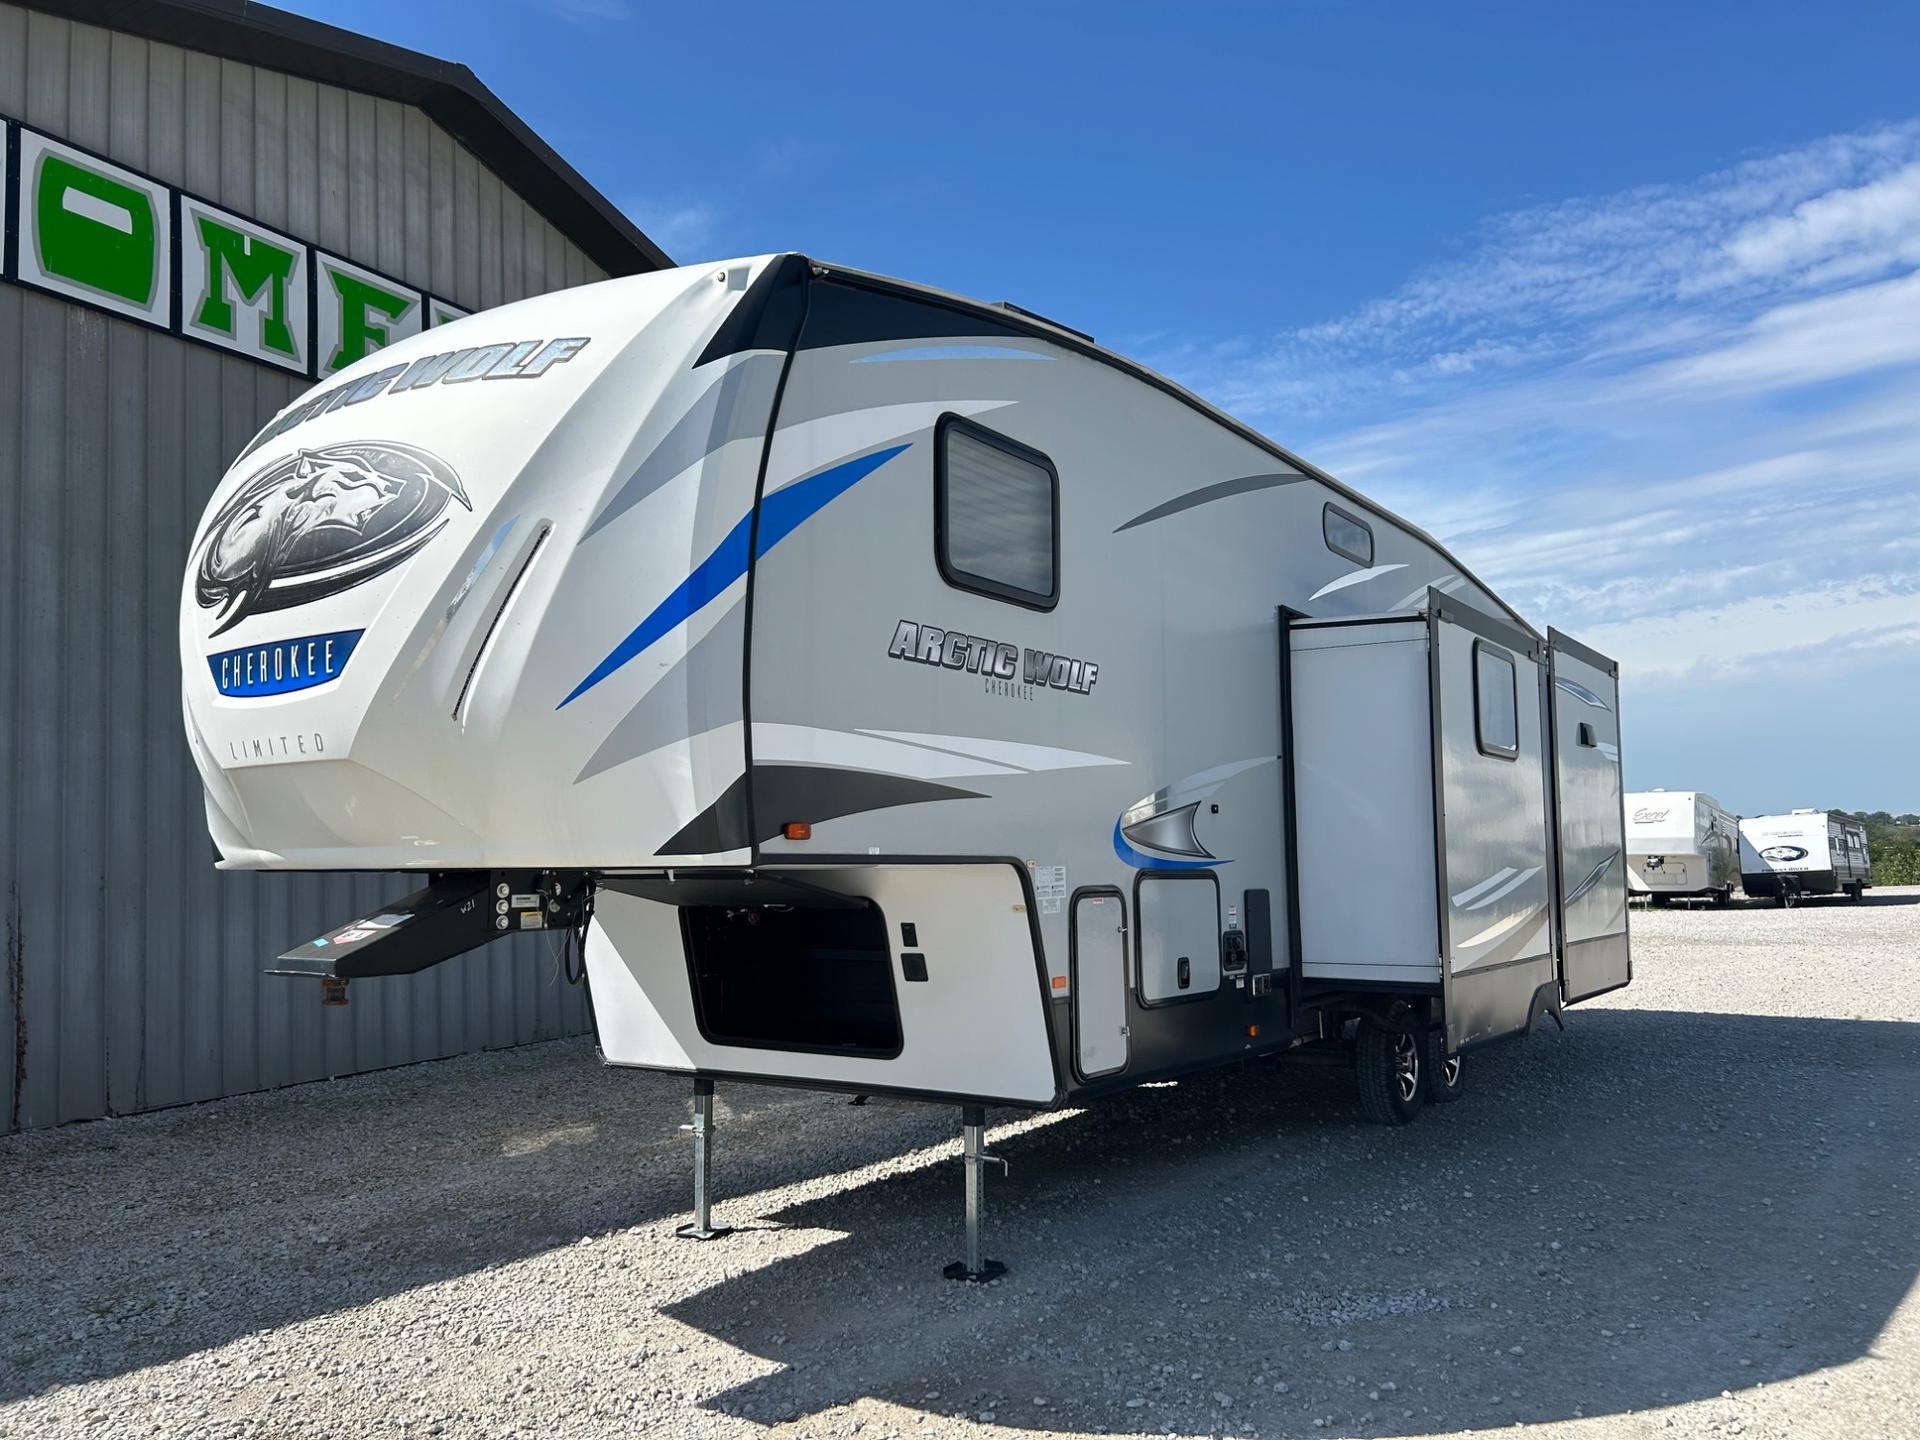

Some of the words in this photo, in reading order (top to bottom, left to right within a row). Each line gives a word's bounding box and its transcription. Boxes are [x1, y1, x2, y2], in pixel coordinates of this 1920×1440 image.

[387, 337, 591, 395] WOLF
[221, 640, 334, 689] CHEROKEE
[888, 619, 1018, 680] ARCTIC
[1023, 648, 1098, 695] WOLF
[985, 678, 1033, 701] CHEROKEE
[230, 733, 324, 760] LIMITED
